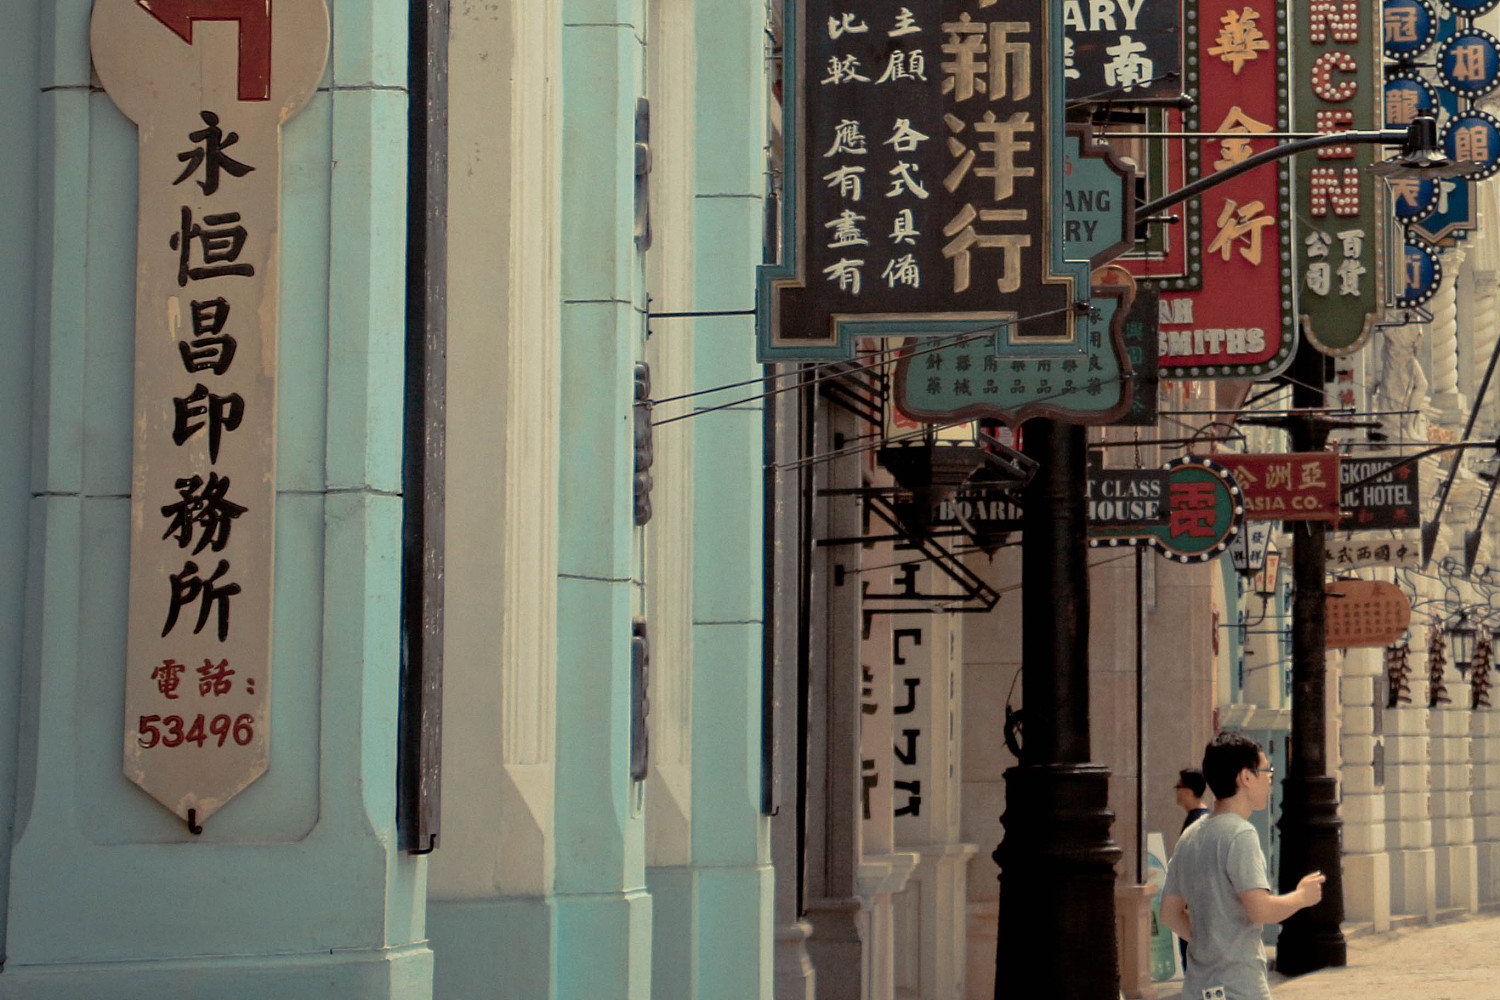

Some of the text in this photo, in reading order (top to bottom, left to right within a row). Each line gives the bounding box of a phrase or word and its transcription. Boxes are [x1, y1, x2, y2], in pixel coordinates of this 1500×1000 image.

[822, 118, 870, 296] 應有盡有
[159, 108, 256, 643] 永恒昌印務所
[1101, 478, 1162, 498] CLASS
[1363, 483, 1413, 507] HOTEL
[1291, 498, 1323, 511] CO.
[136, 712, 256, 752] 53496
